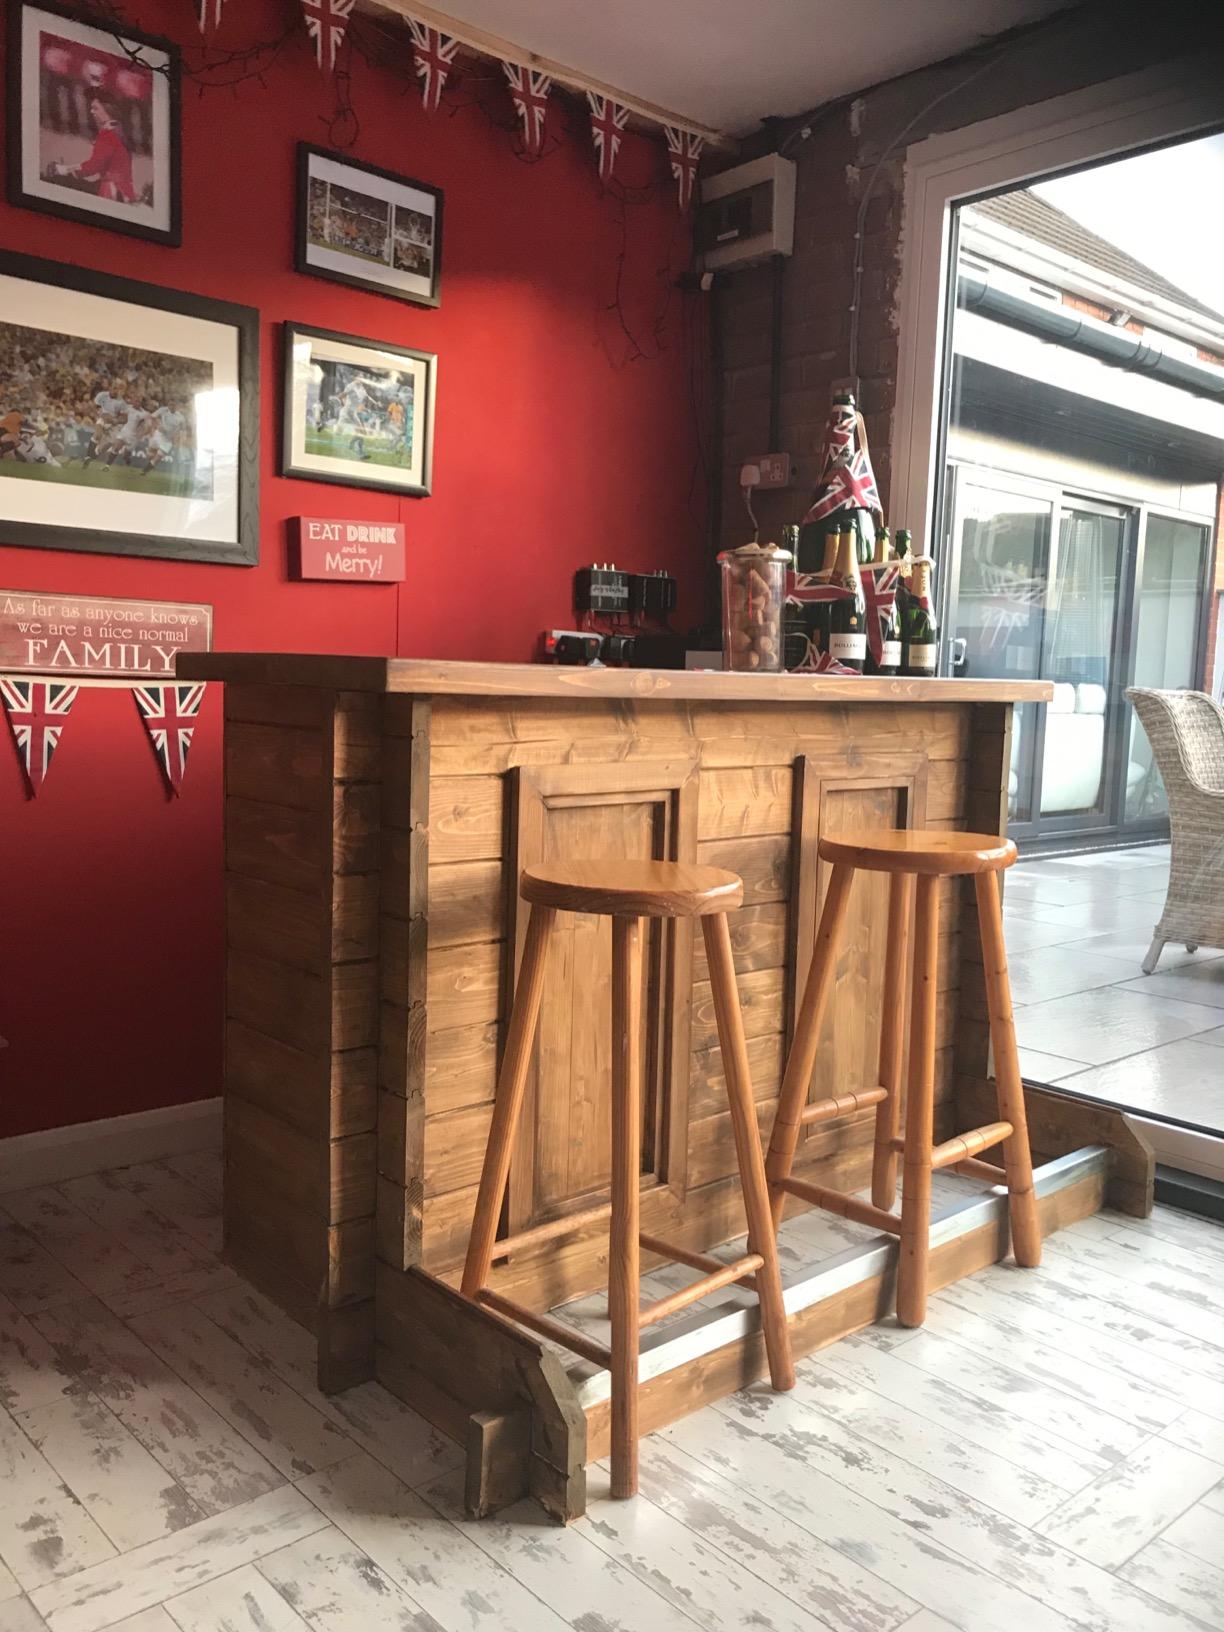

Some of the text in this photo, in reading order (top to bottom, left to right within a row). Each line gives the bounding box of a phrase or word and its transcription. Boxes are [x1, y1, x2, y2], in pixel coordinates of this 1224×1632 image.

[309, 523, 397, 544] EAT DRINK
[341, 544, 367, 554] and be
[325, 552, 383, 578] Merry!
[3, 597, 198, 625] As far as anyone knows
[17, 622, 188, 642] we are a nice normal
[24, 638, 181, 671] FAMILY
